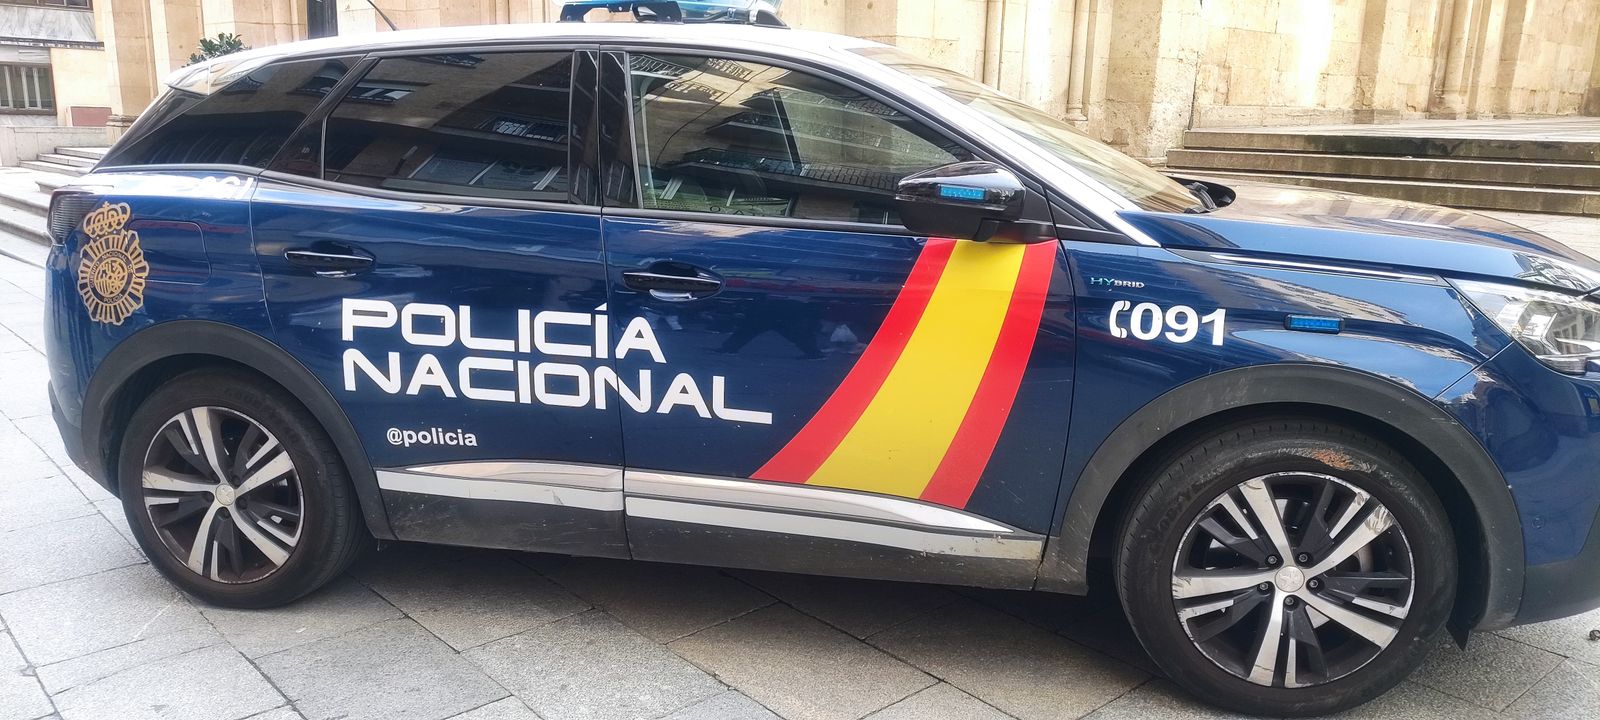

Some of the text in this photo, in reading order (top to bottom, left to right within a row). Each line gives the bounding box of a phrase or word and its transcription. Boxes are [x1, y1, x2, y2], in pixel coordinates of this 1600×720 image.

[1090, 277, 1145, 289] HYBRID
[342, 297, 667, 364] POLICÍA
[1130, 302, 1227, 346] 091
[342, 348, 773, 425] NACIONAL
[386, 427, 478, 448] @policia
